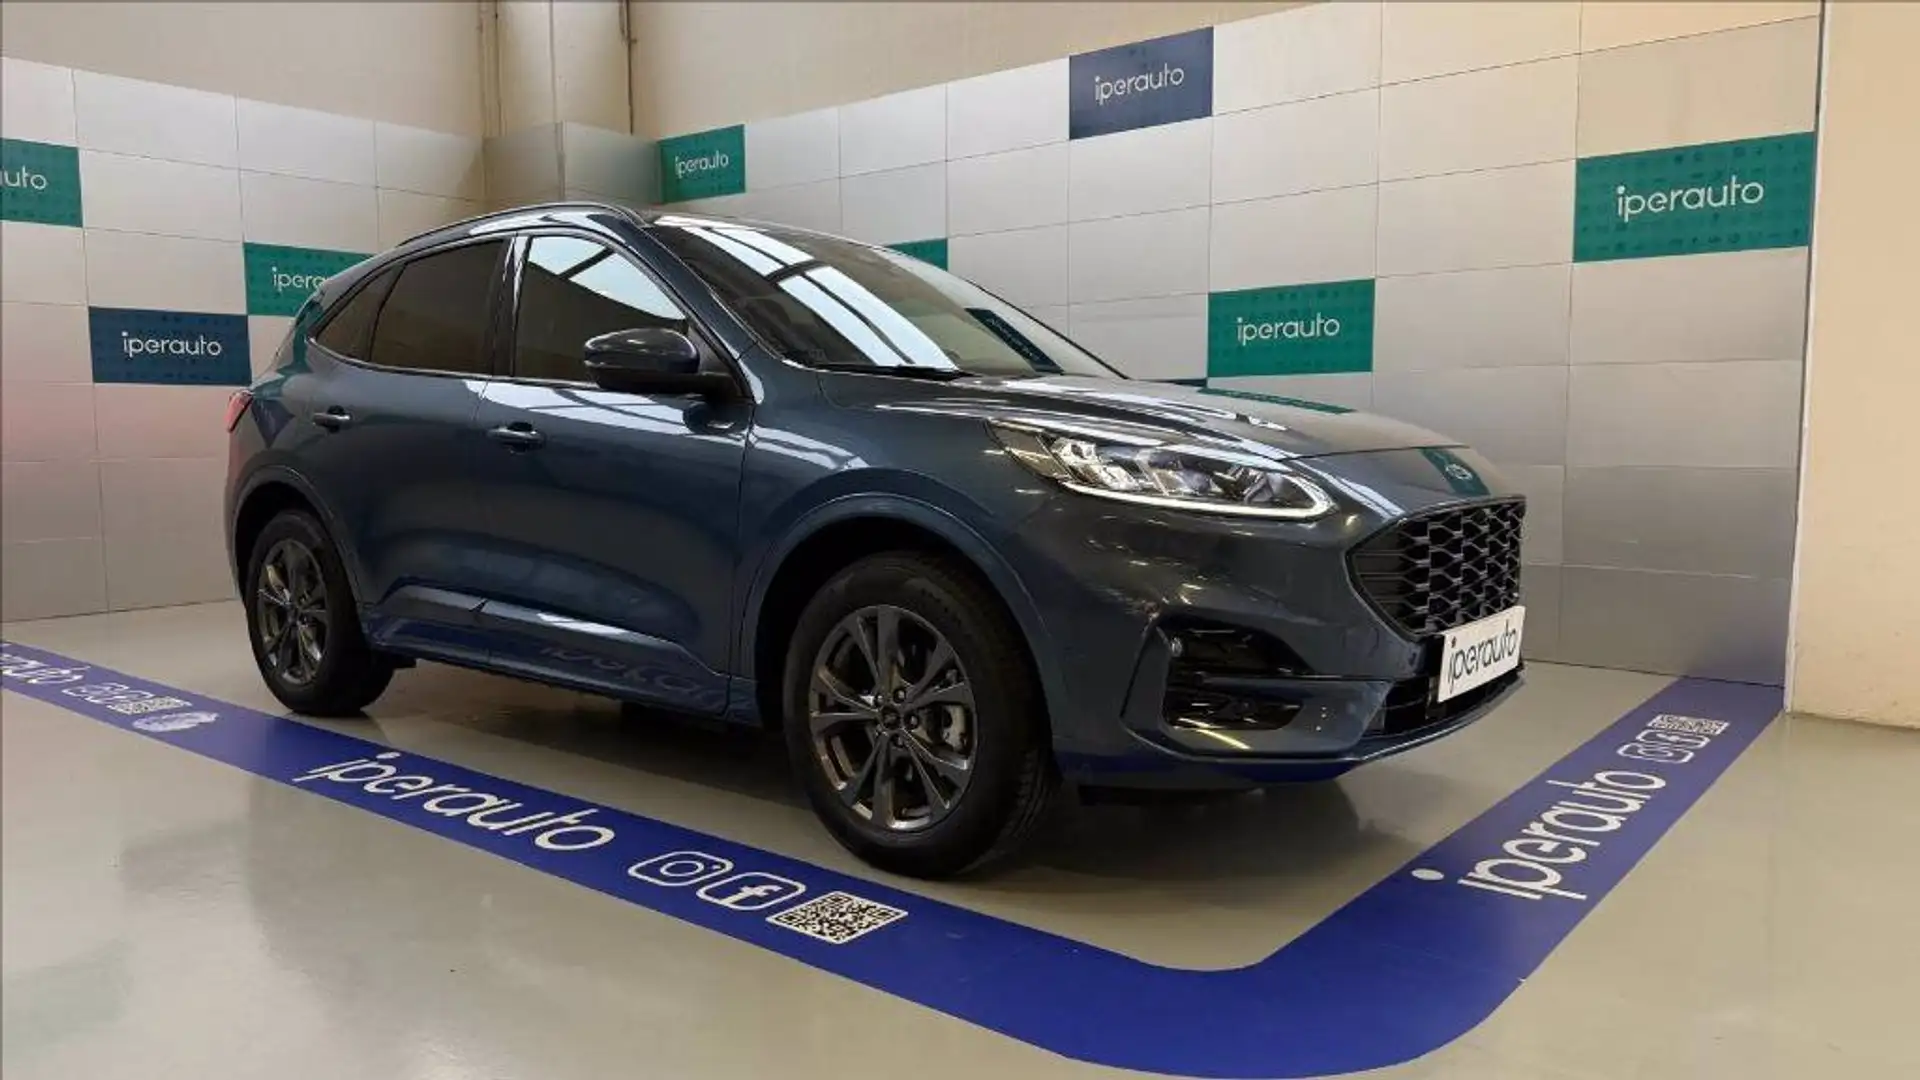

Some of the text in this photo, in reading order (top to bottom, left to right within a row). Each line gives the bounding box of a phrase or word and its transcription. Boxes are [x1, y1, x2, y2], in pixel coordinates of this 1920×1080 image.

[1094, 62, 1184, 106] iperauto
[674, 150, 729, 179] iperauto
[1615, 174, 1765, 223] iperauto
[121, 331, 222, 358] iperauto
[1236, 312, 1341, 346] iperauto
[1447, 619, 1517, 695] iperauto
[292, 751, 615, 851] iperauto
[1410, 769, 1667, 901] iperauto
